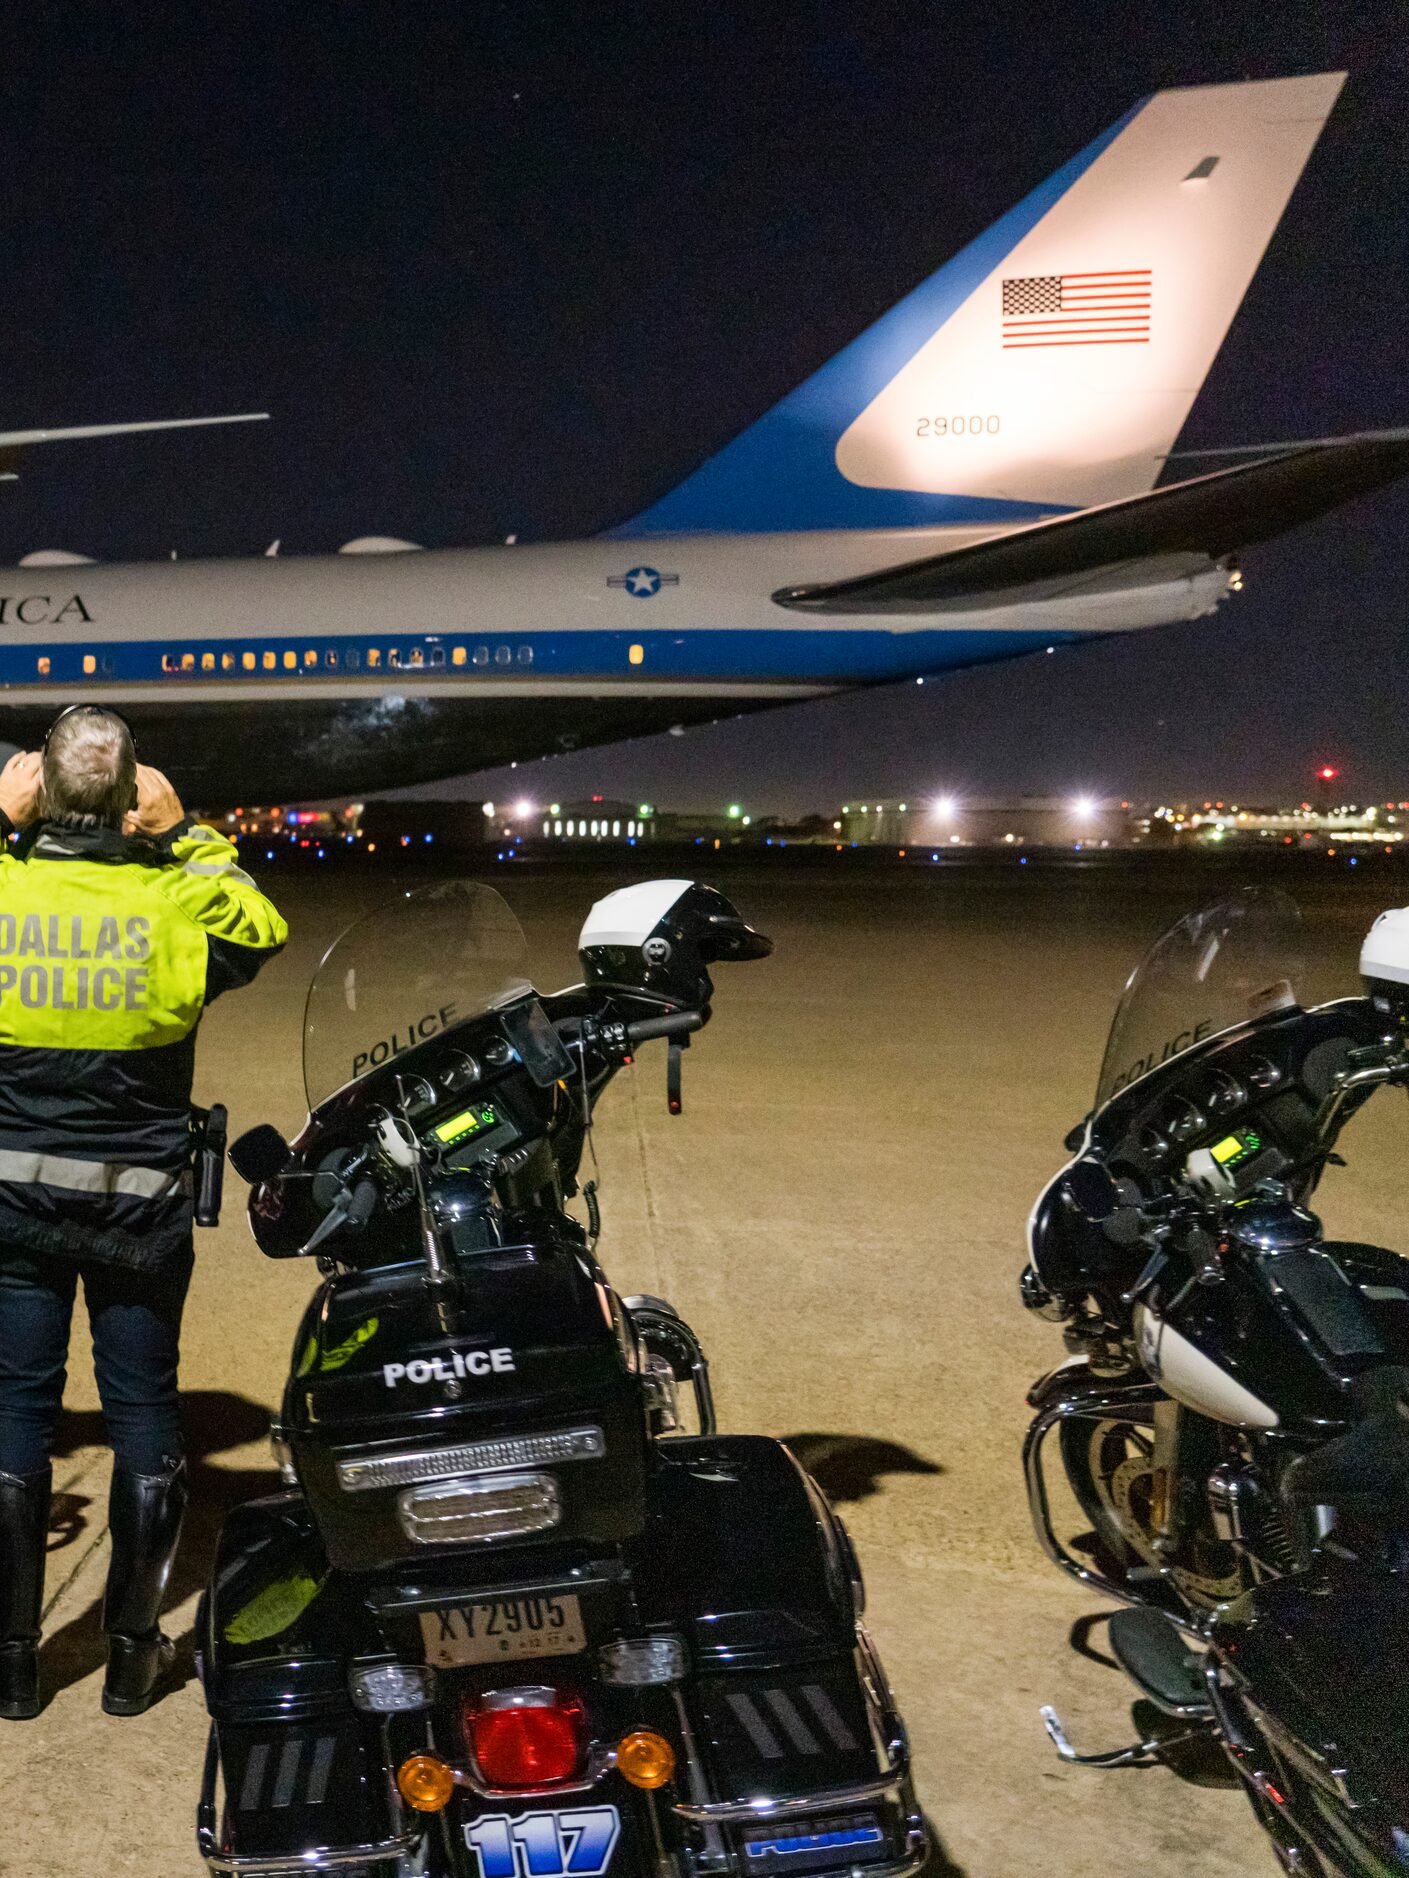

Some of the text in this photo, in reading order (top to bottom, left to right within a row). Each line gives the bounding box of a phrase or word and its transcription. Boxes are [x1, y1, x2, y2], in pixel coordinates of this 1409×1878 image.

[917, 415, 1000, 437] 29000
[352, 1001, 457, 1080] POLICE
[383, 1347, 516, 1388] POLICE
[436, 1596, 565, 1642] XY2905
[464, 1804, 621, 1878] 117
